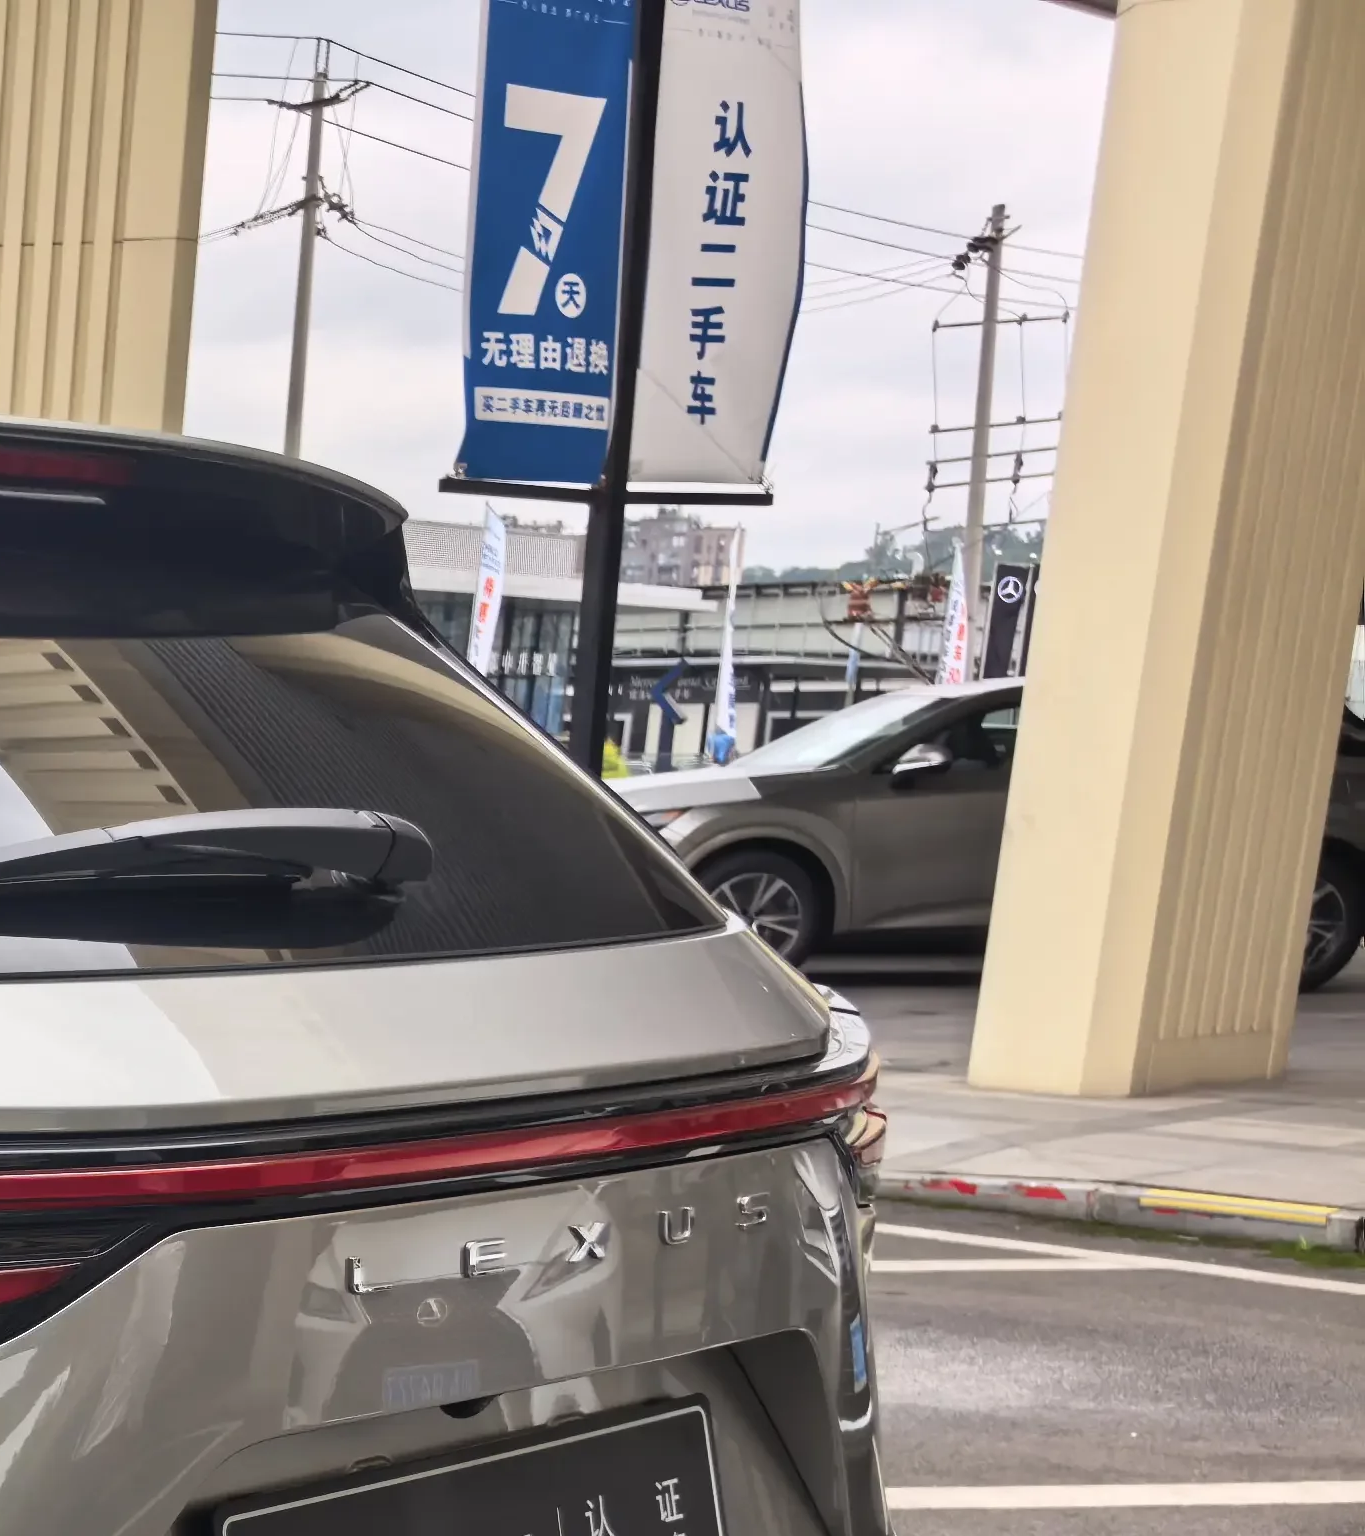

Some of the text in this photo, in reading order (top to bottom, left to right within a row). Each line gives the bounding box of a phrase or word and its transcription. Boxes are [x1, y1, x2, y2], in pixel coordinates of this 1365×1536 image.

[497, 83, 608, 316] 7
[561, 280, 581, 309] 天
[687, 100, 753, 425] 认证二手车
[480, 331, 609, 375] 无理由退换
[346, 1192, 769, 1295] LEXUS
